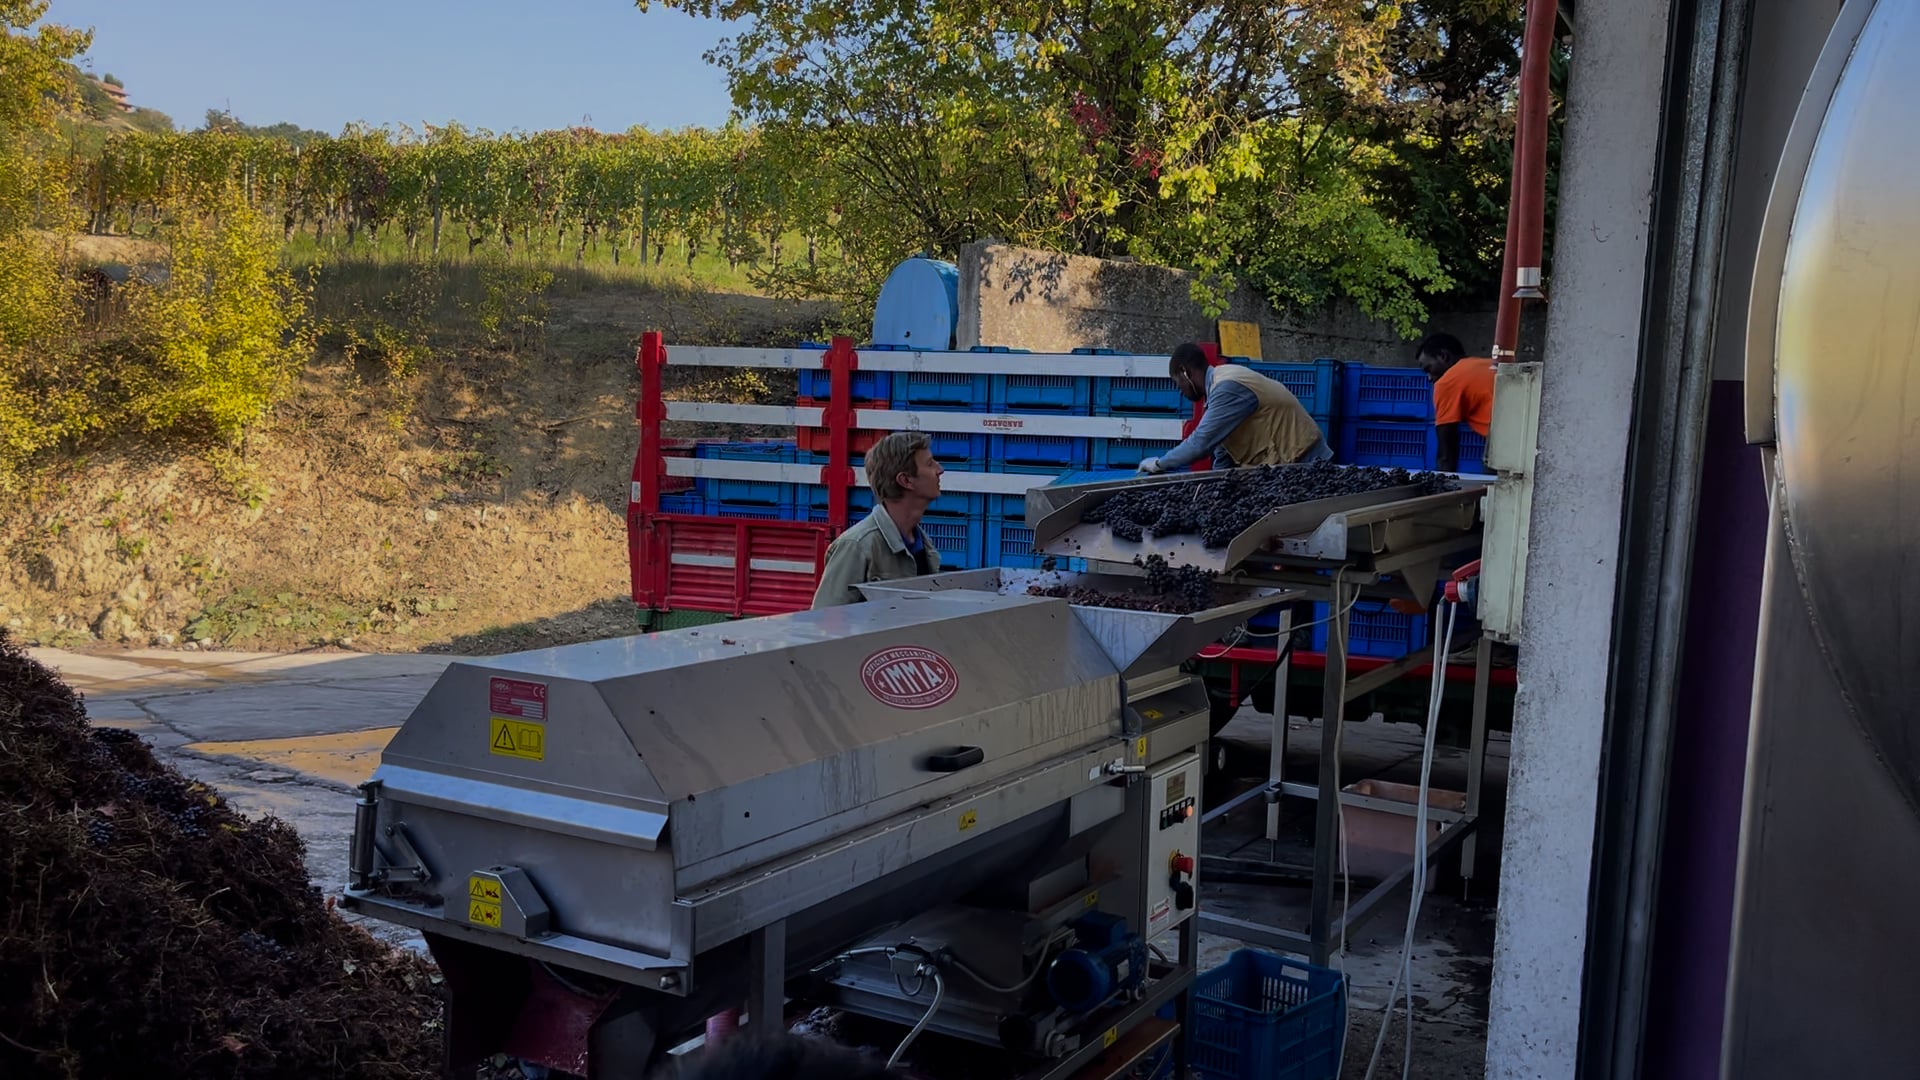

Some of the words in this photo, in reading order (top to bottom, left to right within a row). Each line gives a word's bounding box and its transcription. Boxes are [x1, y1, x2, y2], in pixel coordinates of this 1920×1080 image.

[866, 655, 889, 677] OFFICINE
[880, 660, 943, 694] IMMA
[533, 686, 545, 698] CE
